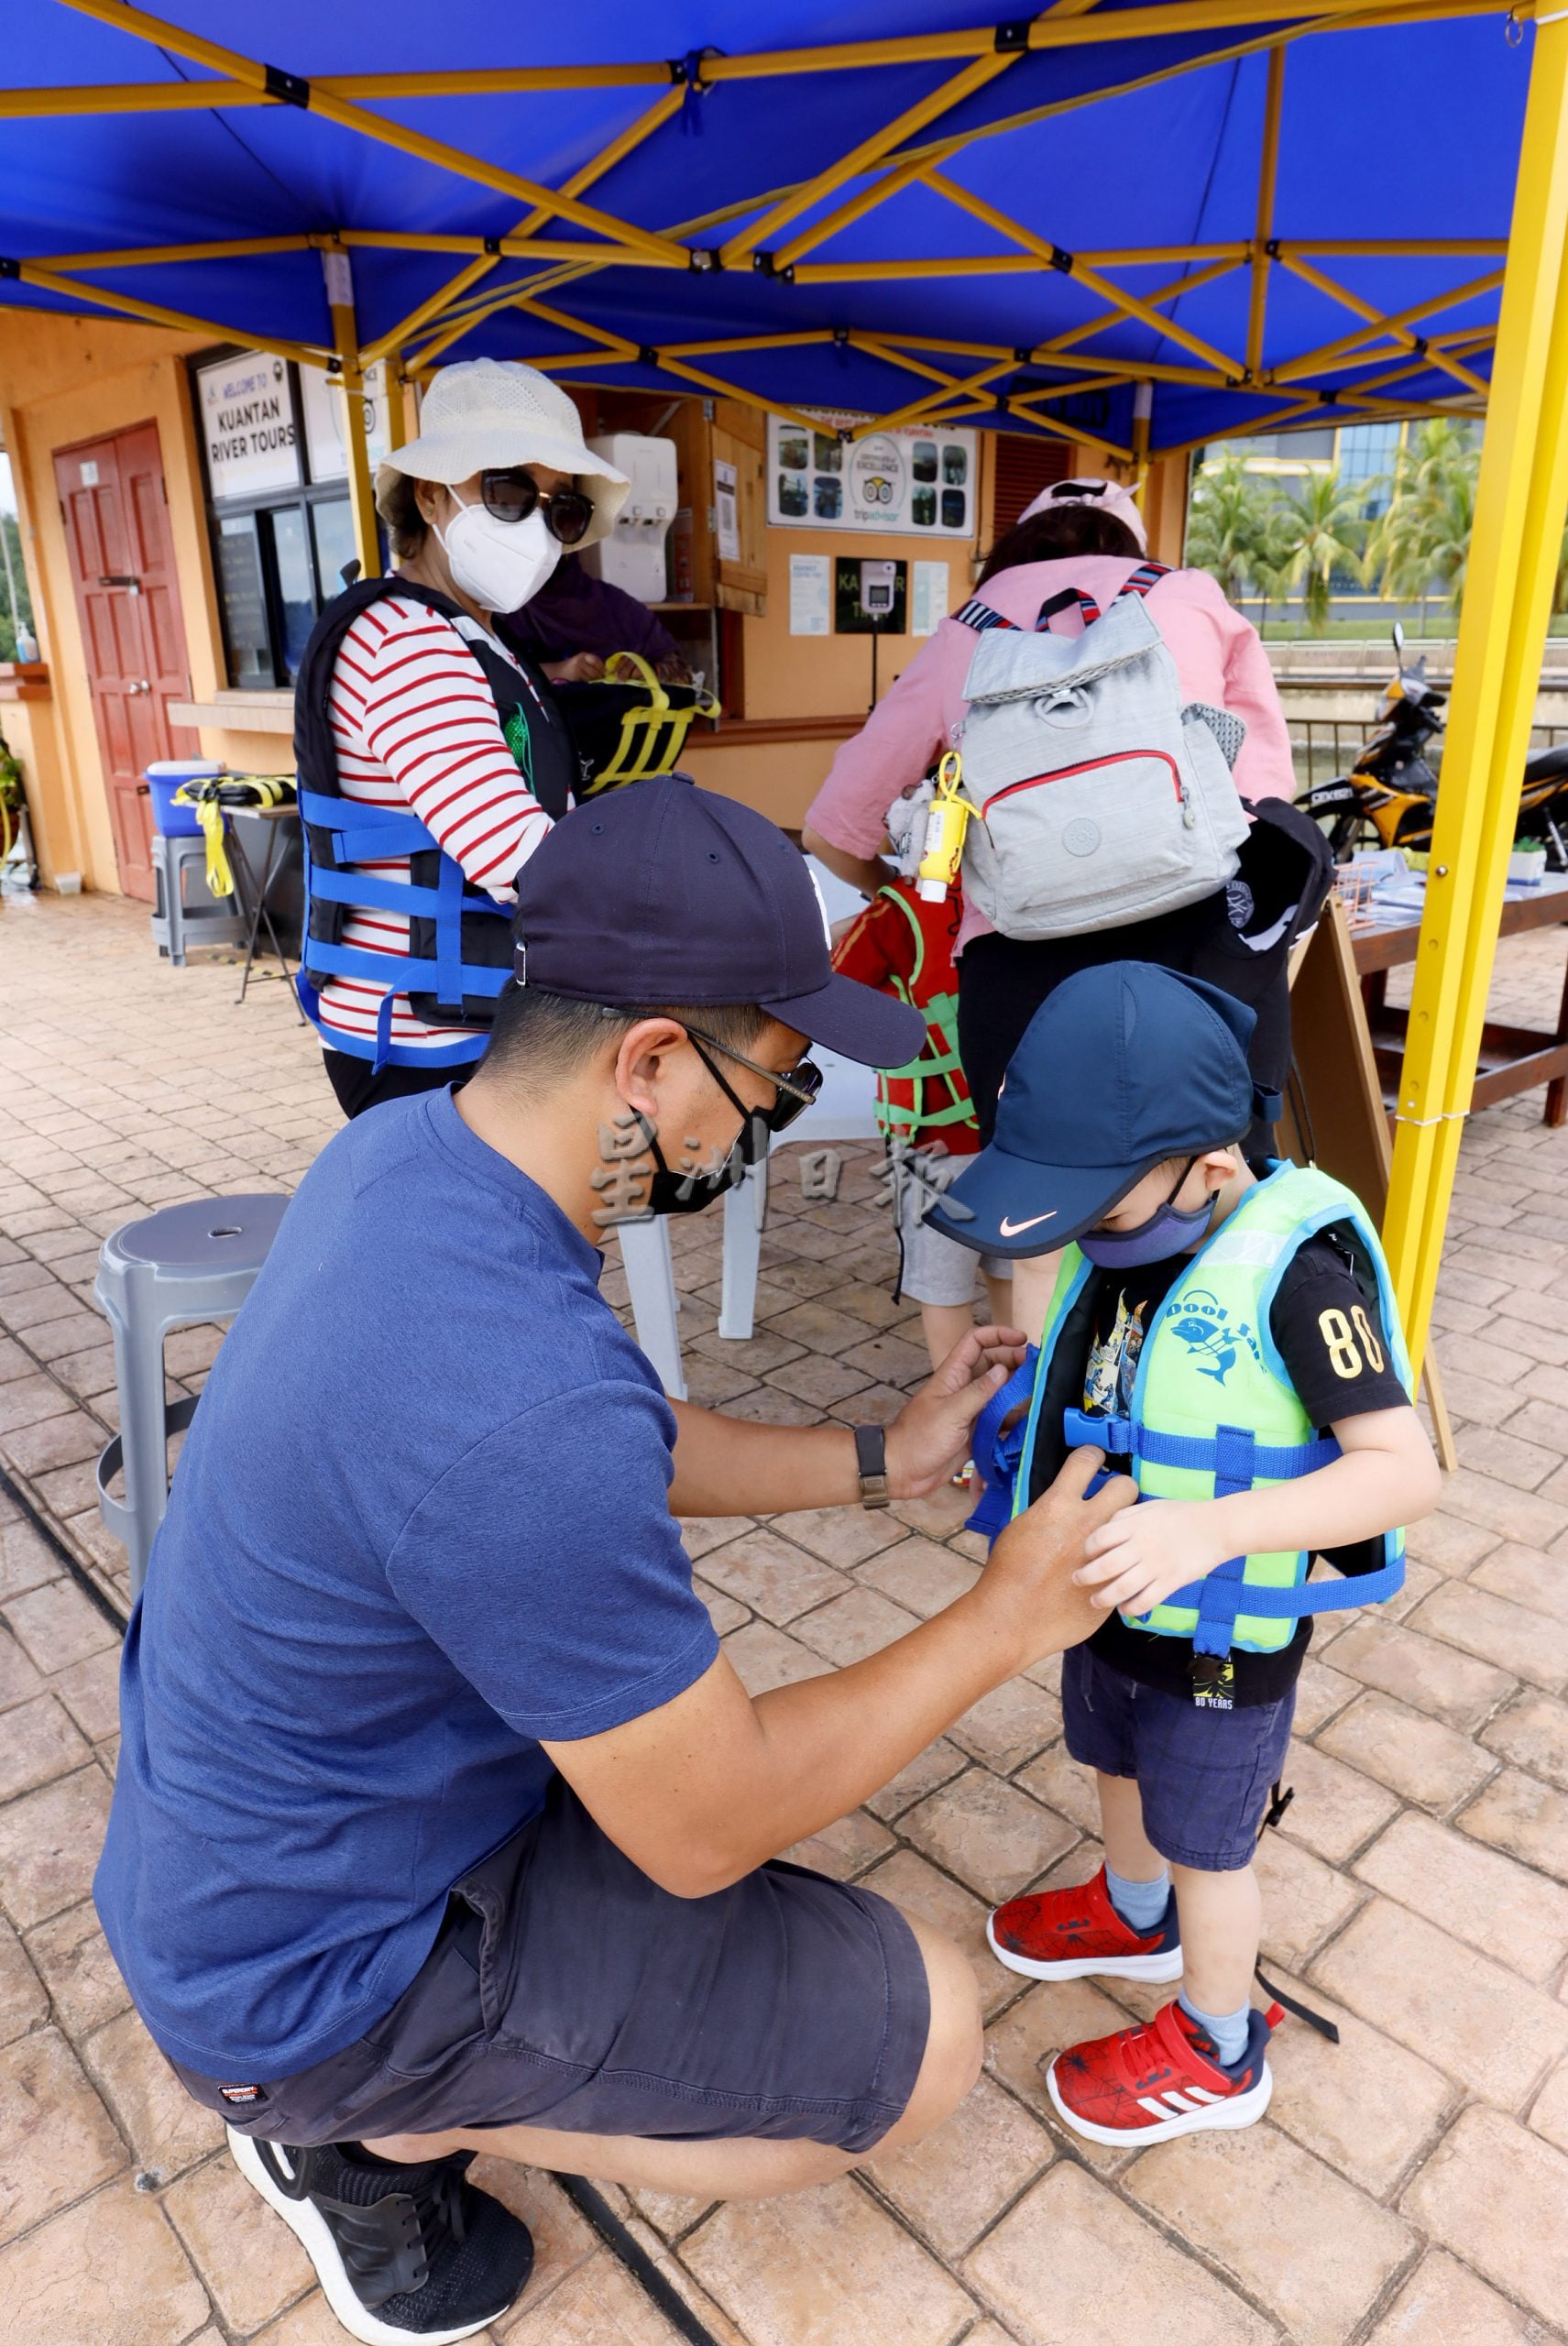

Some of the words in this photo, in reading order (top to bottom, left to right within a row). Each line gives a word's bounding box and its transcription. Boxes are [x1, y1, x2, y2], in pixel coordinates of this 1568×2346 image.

[224, 376, 255, 400] WELCOME
[257, 372, 268, 389] TO
[217, 397, 280, 433] KUANTAN
[211, 434, 248, 463] RIVER
[250, 423, 296, 454] TOURS
[1318, 1305, 1385, 1378] 80
[1195, 1696, 1206, 1706] 80
[1208, 1698, 1233, 1710] YEARS
